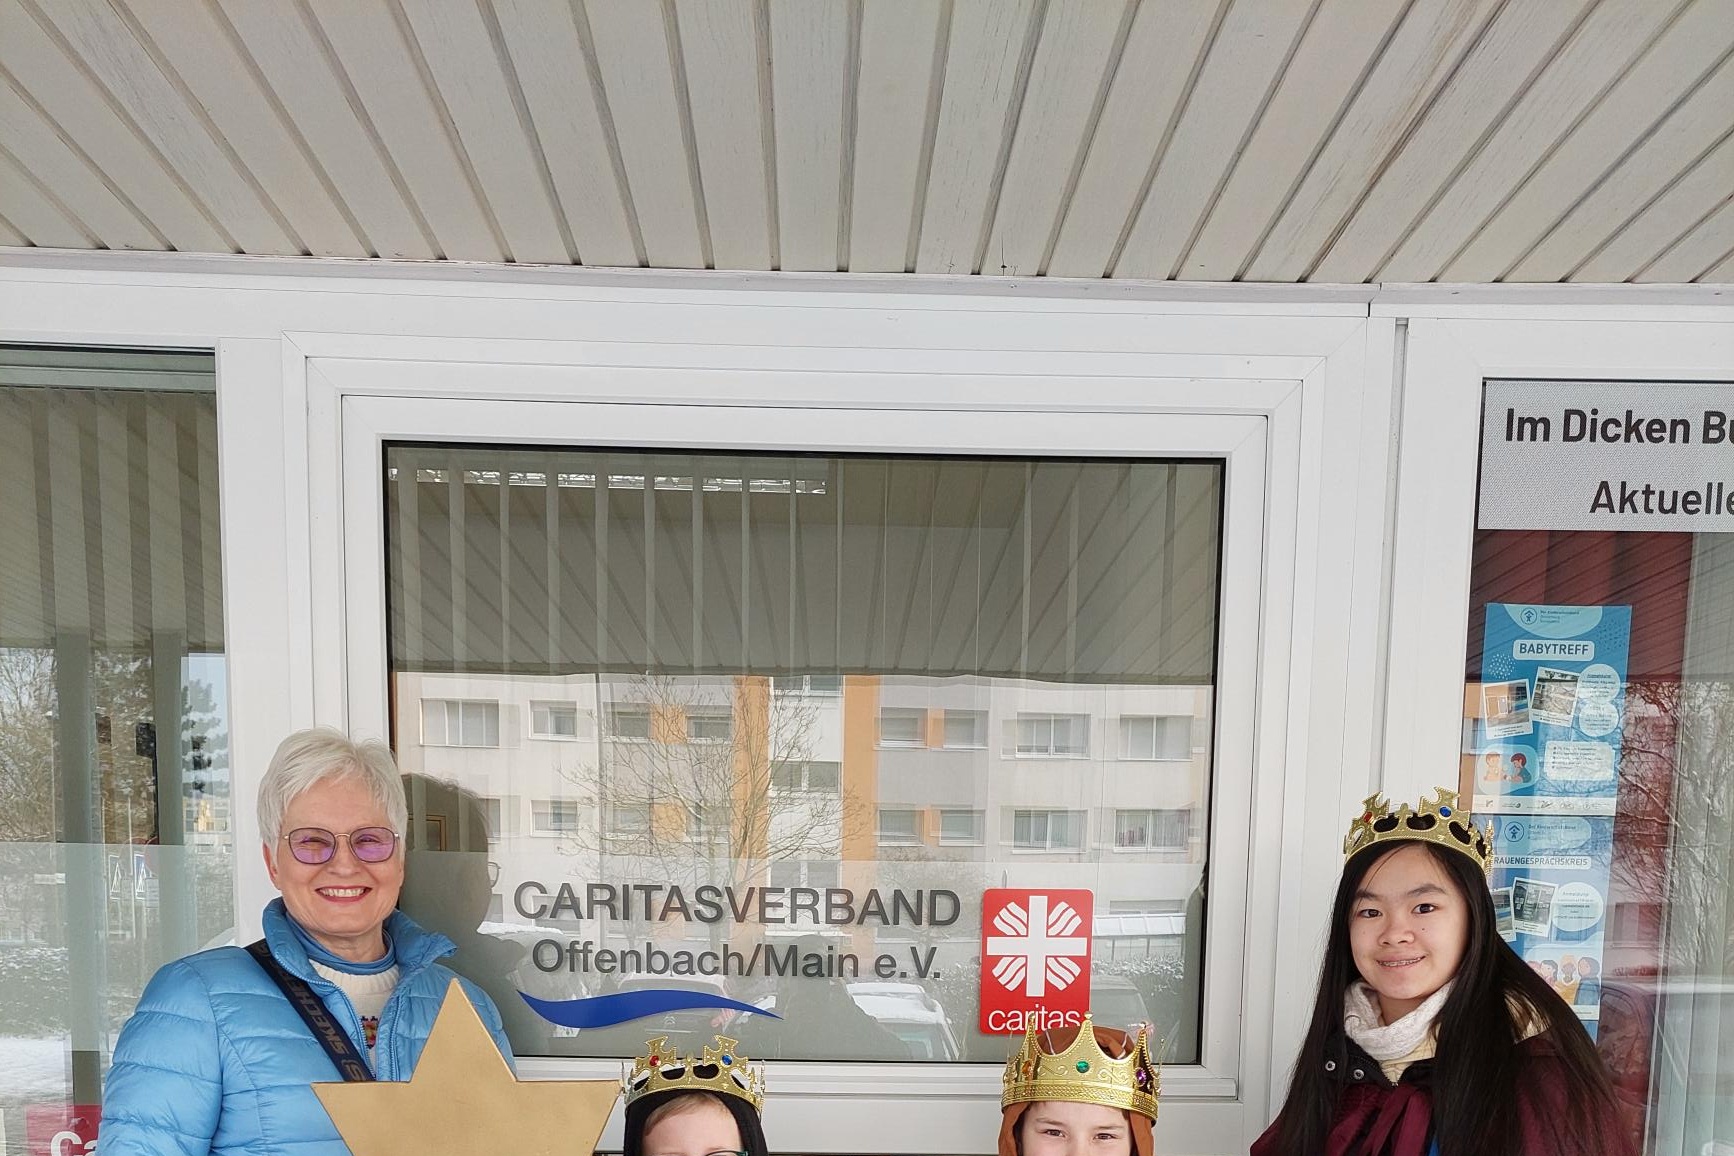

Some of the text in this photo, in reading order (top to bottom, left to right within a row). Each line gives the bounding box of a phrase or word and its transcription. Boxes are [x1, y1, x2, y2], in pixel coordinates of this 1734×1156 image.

[1506, 408, 1734, 445] Im Dicken B
[1519, 643, 1589, 655] BABYTREFF
[513, 880, 961, 926] CARITASVERBAND
[532, 939, 941, 979] Offenbach/Main e.V.
[988, 1003, 1081, 1032] caritas
